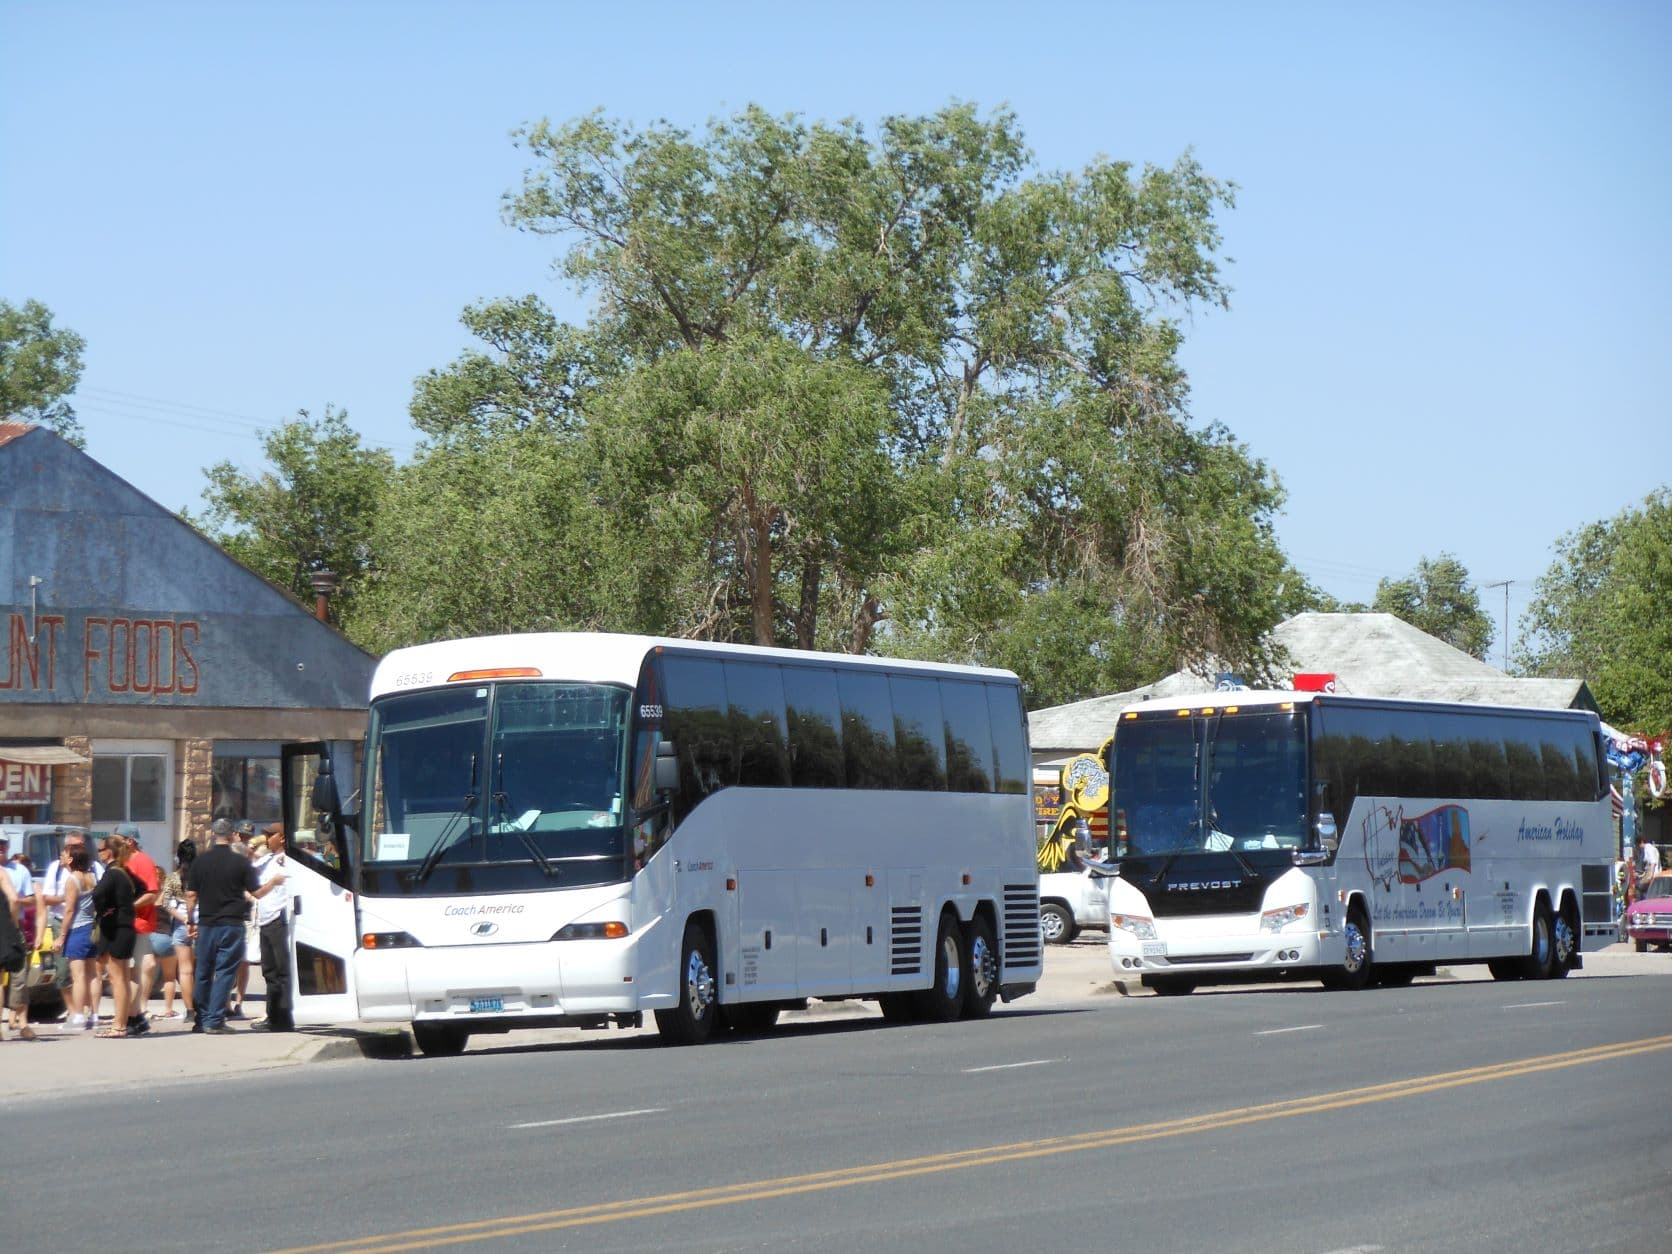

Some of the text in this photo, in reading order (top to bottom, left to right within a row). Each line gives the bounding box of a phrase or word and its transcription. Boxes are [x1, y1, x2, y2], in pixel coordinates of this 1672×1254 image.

[85, 616, 200, 697] FOODS
[396, 671, 433, 687] 65539
[640, 704, 663, 718] 65539
[0, 764, 40, 792] EN
[1517, 816, 1584, 846] American Holiday
[1168, 880, 1242, 891] PREVOST
[444, 903, 525, 916] Coach America
